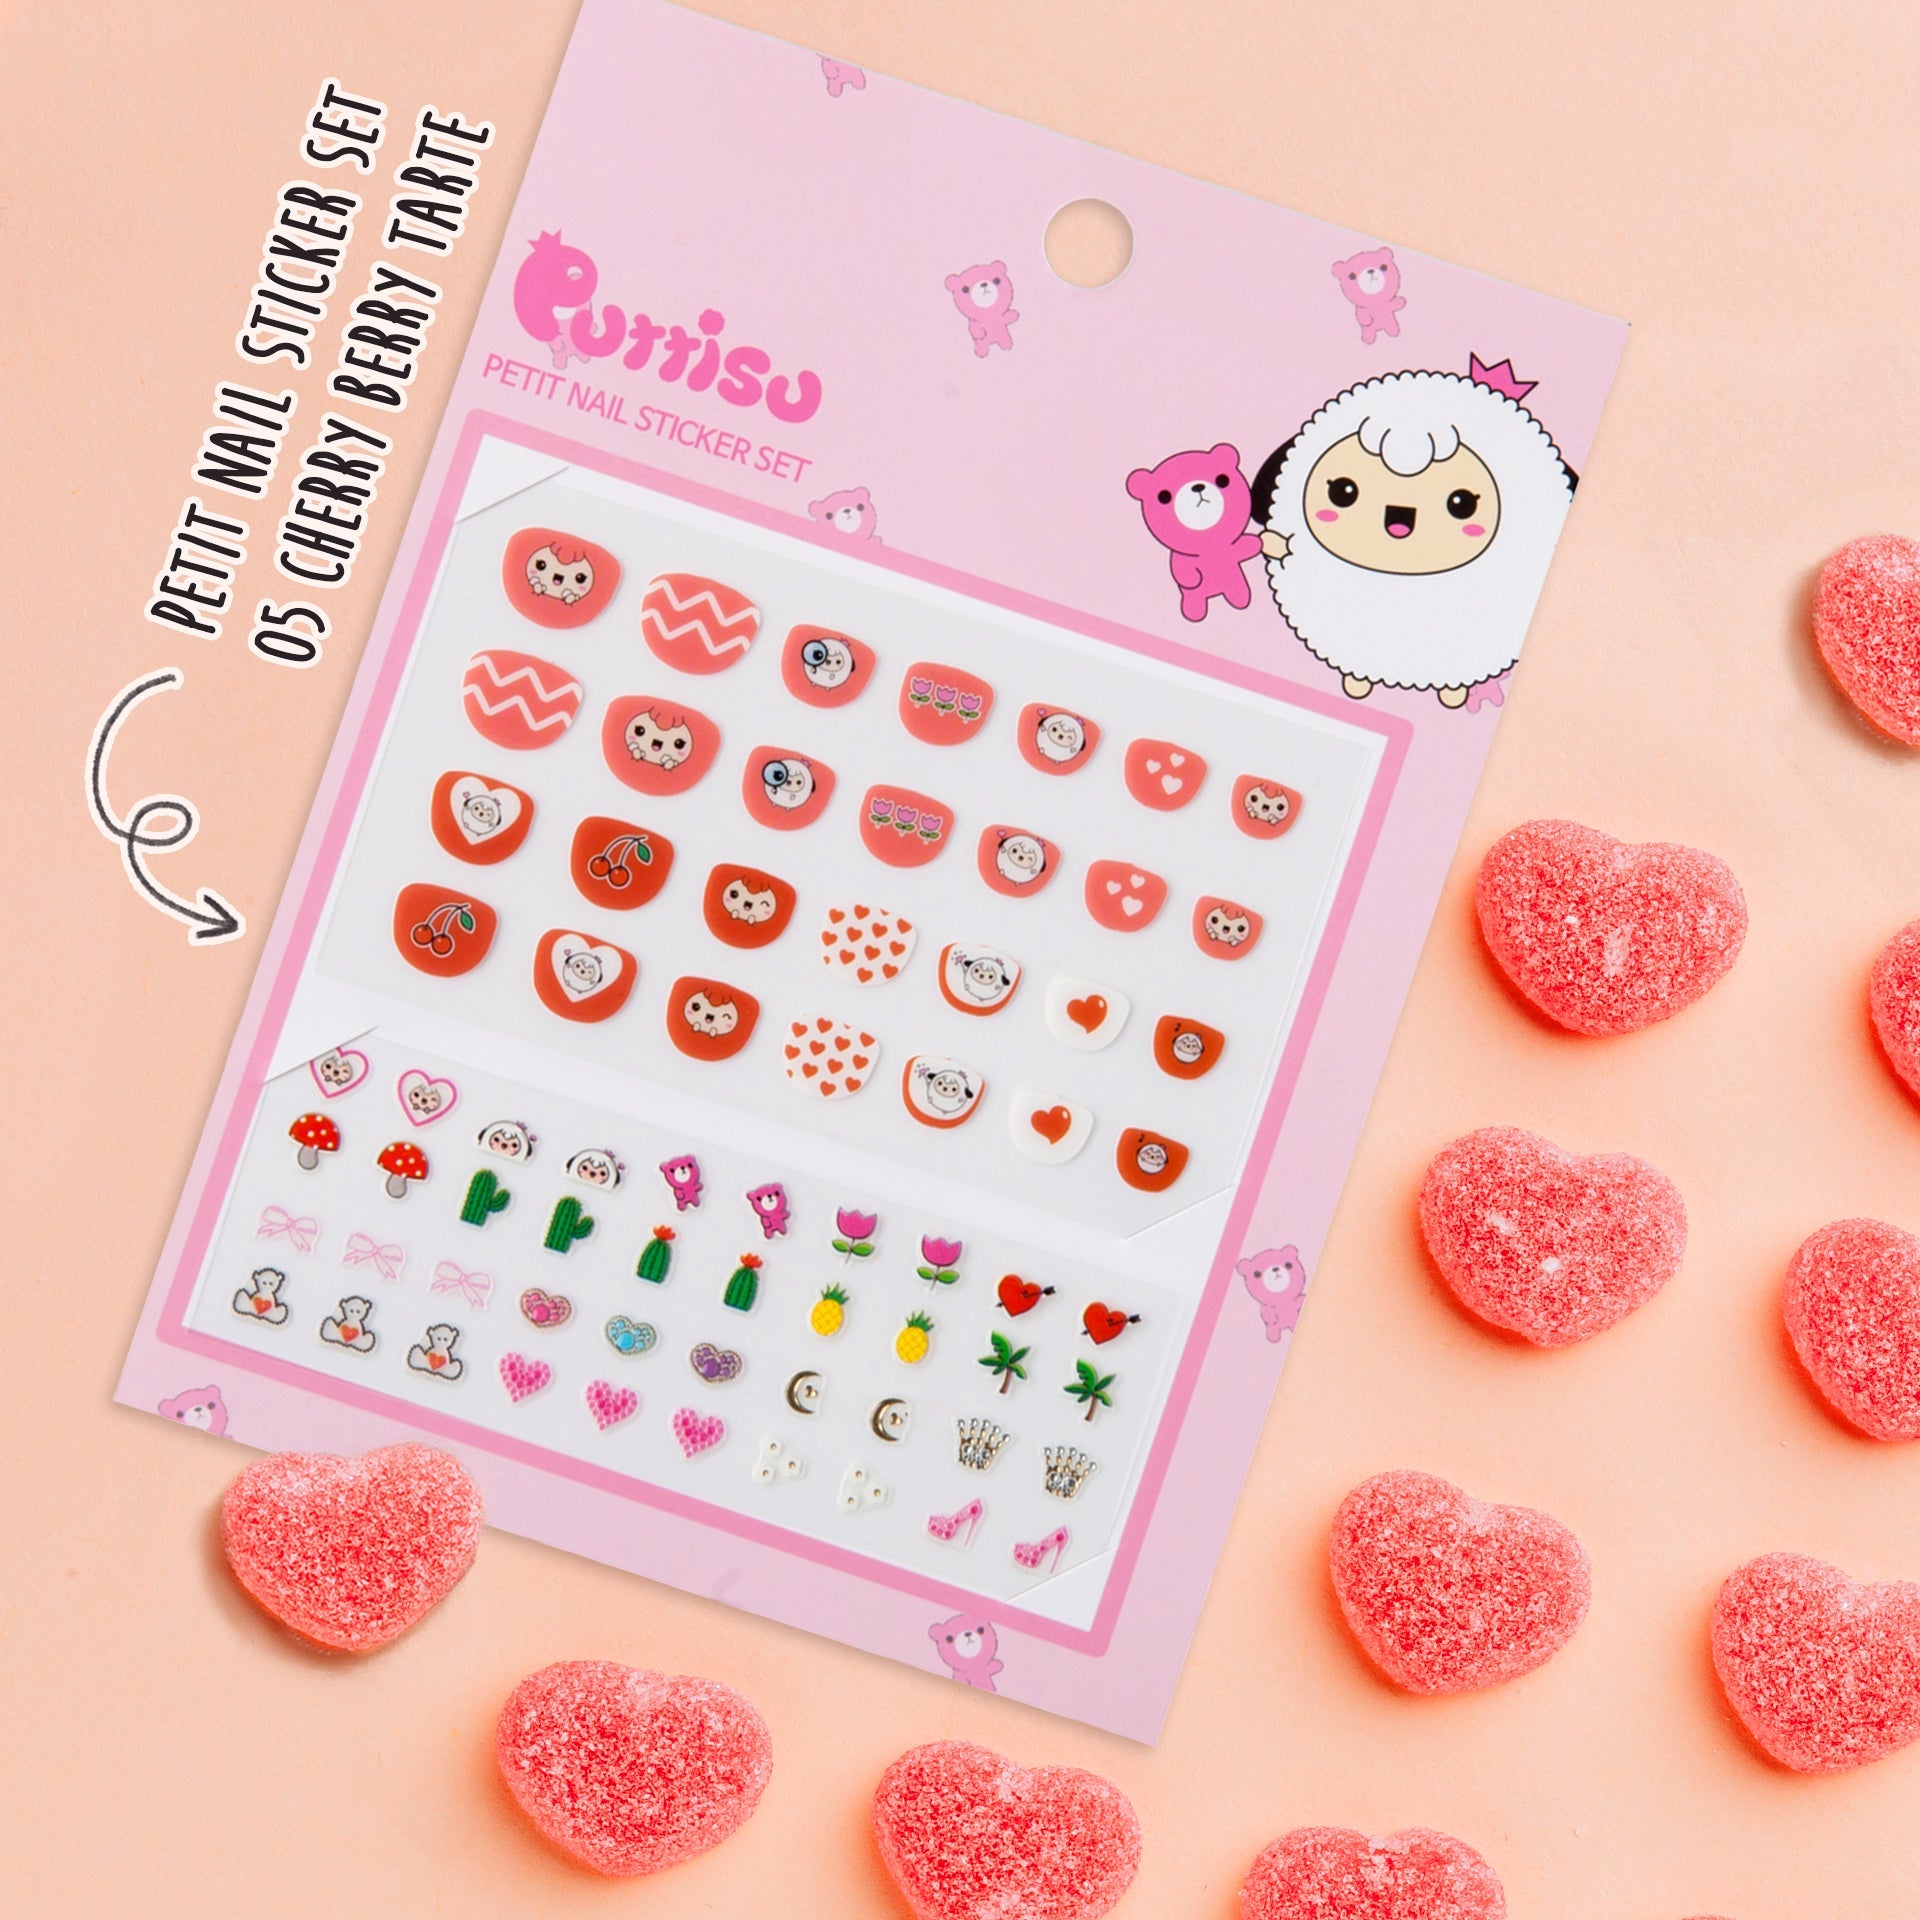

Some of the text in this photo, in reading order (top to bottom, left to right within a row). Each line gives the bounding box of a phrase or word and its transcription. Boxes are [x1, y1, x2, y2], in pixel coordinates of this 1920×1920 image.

[514, 230, 823, 424] Puttisu
[482, 353, 813, 483] PETIT NAIL STICKER SET
